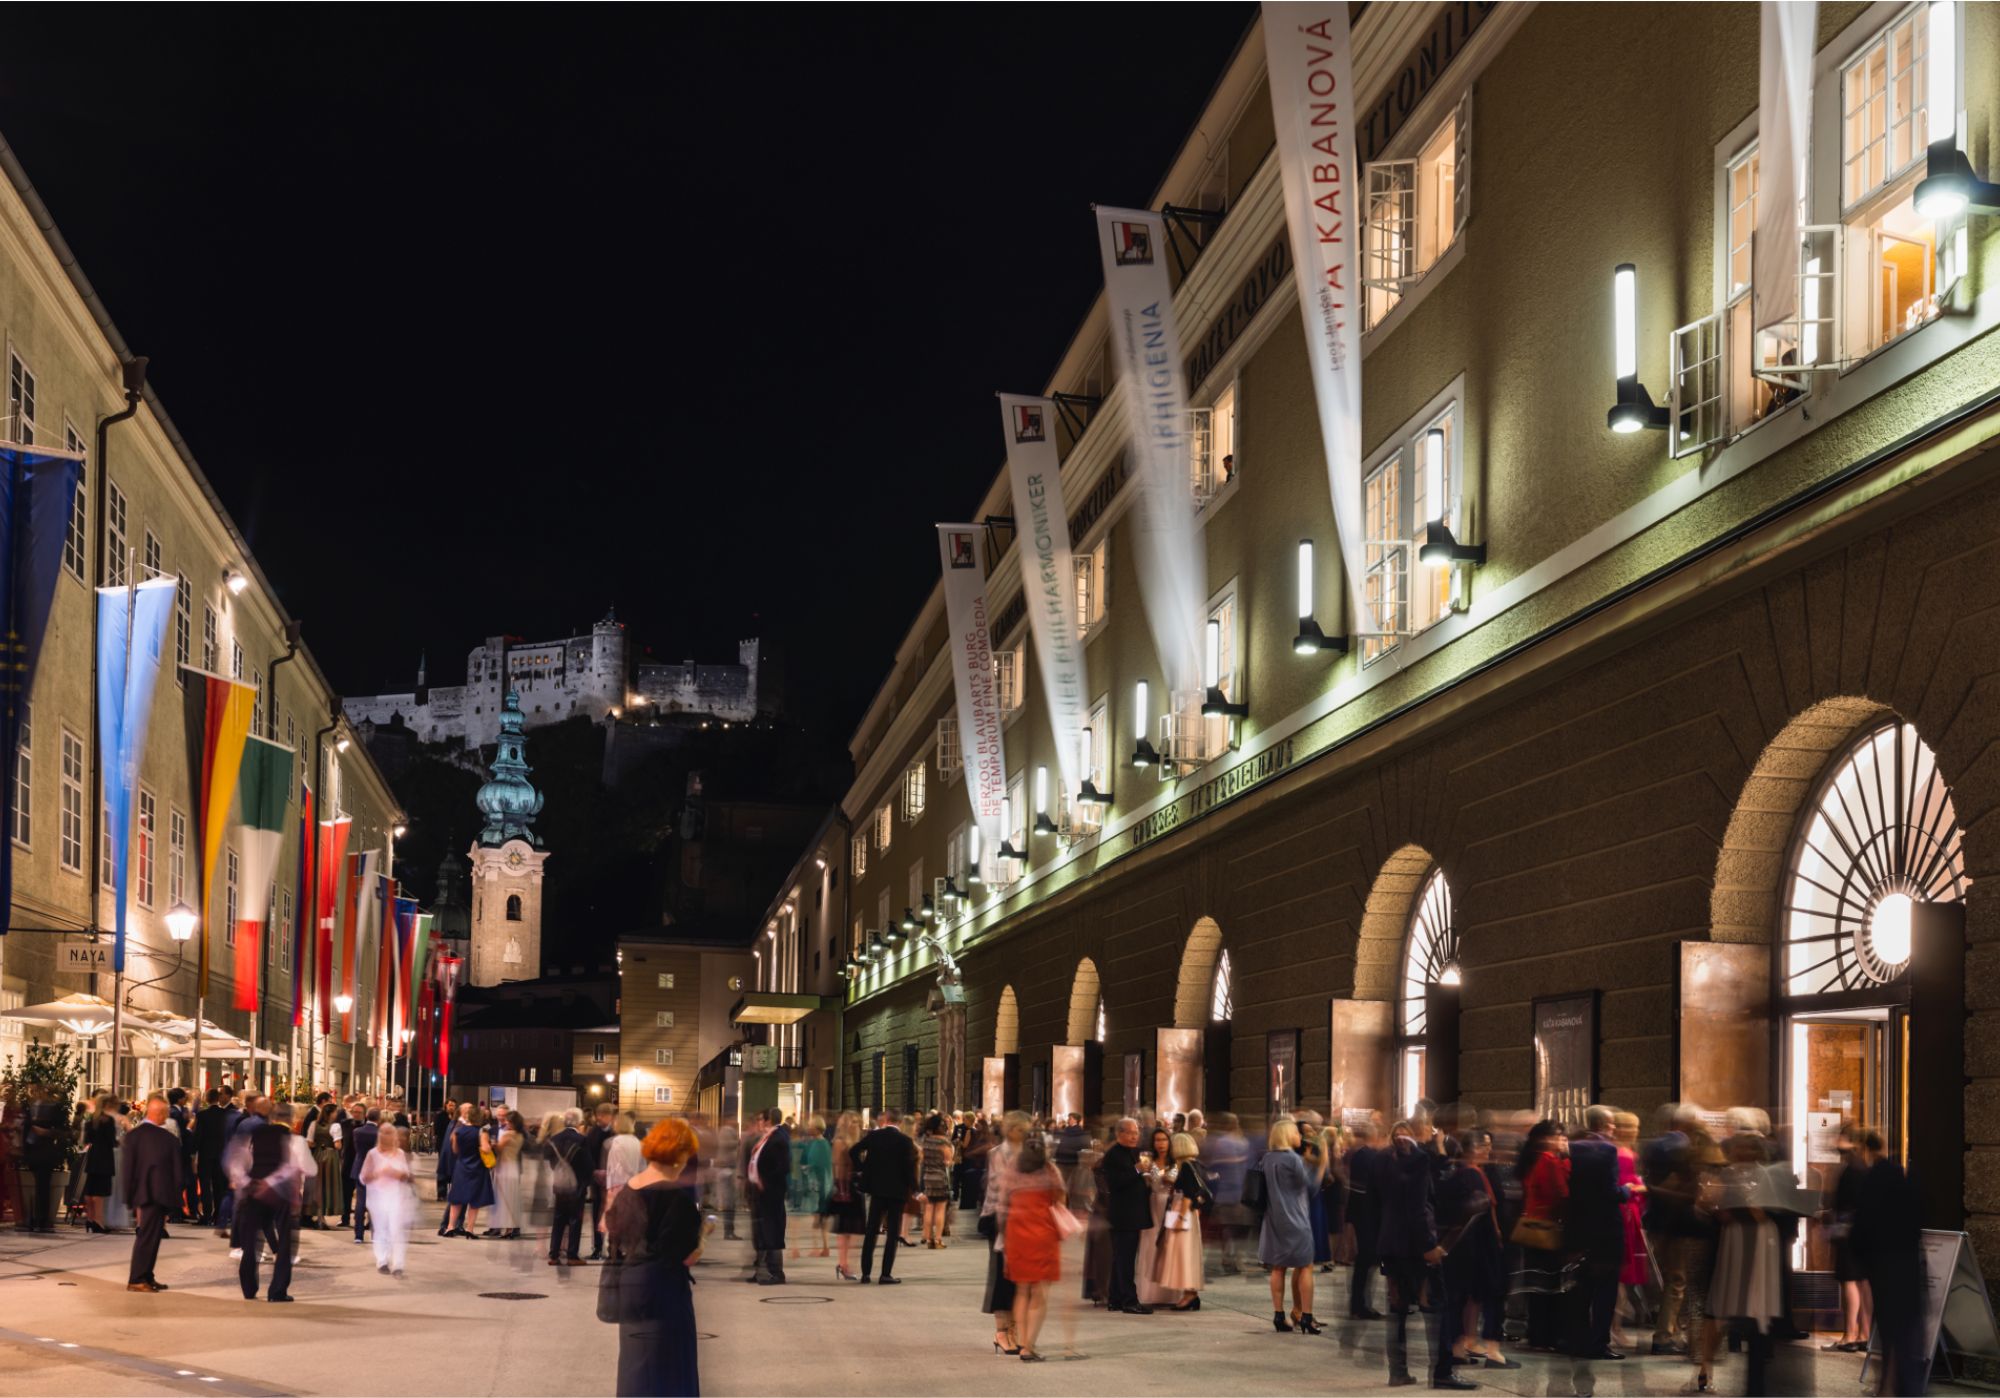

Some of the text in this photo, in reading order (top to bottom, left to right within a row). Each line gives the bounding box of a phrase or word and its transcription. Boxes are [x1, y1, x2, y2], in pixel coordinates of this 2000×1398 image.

[1356, 1, 1500, 177] TTONIT
[1298, 17, 1344, 244] KABANOVÁ
[1140, 300, 1184, 449] IPHIGENIA
[1027, 473, 1075, 663] PHILHARMONIKER
[965, 632, 979, 670] BURG
[973, 597, 990, 671] COMOEDIA
[969, 673, 986, 755] BLAUBARTS
[982, 678, 993, 709] FINE
[978, 758, 991, 817] HERZOG
[986, 709, 1002, 795] TEMPORUM
[70, 949, 106, 962] NAYA
